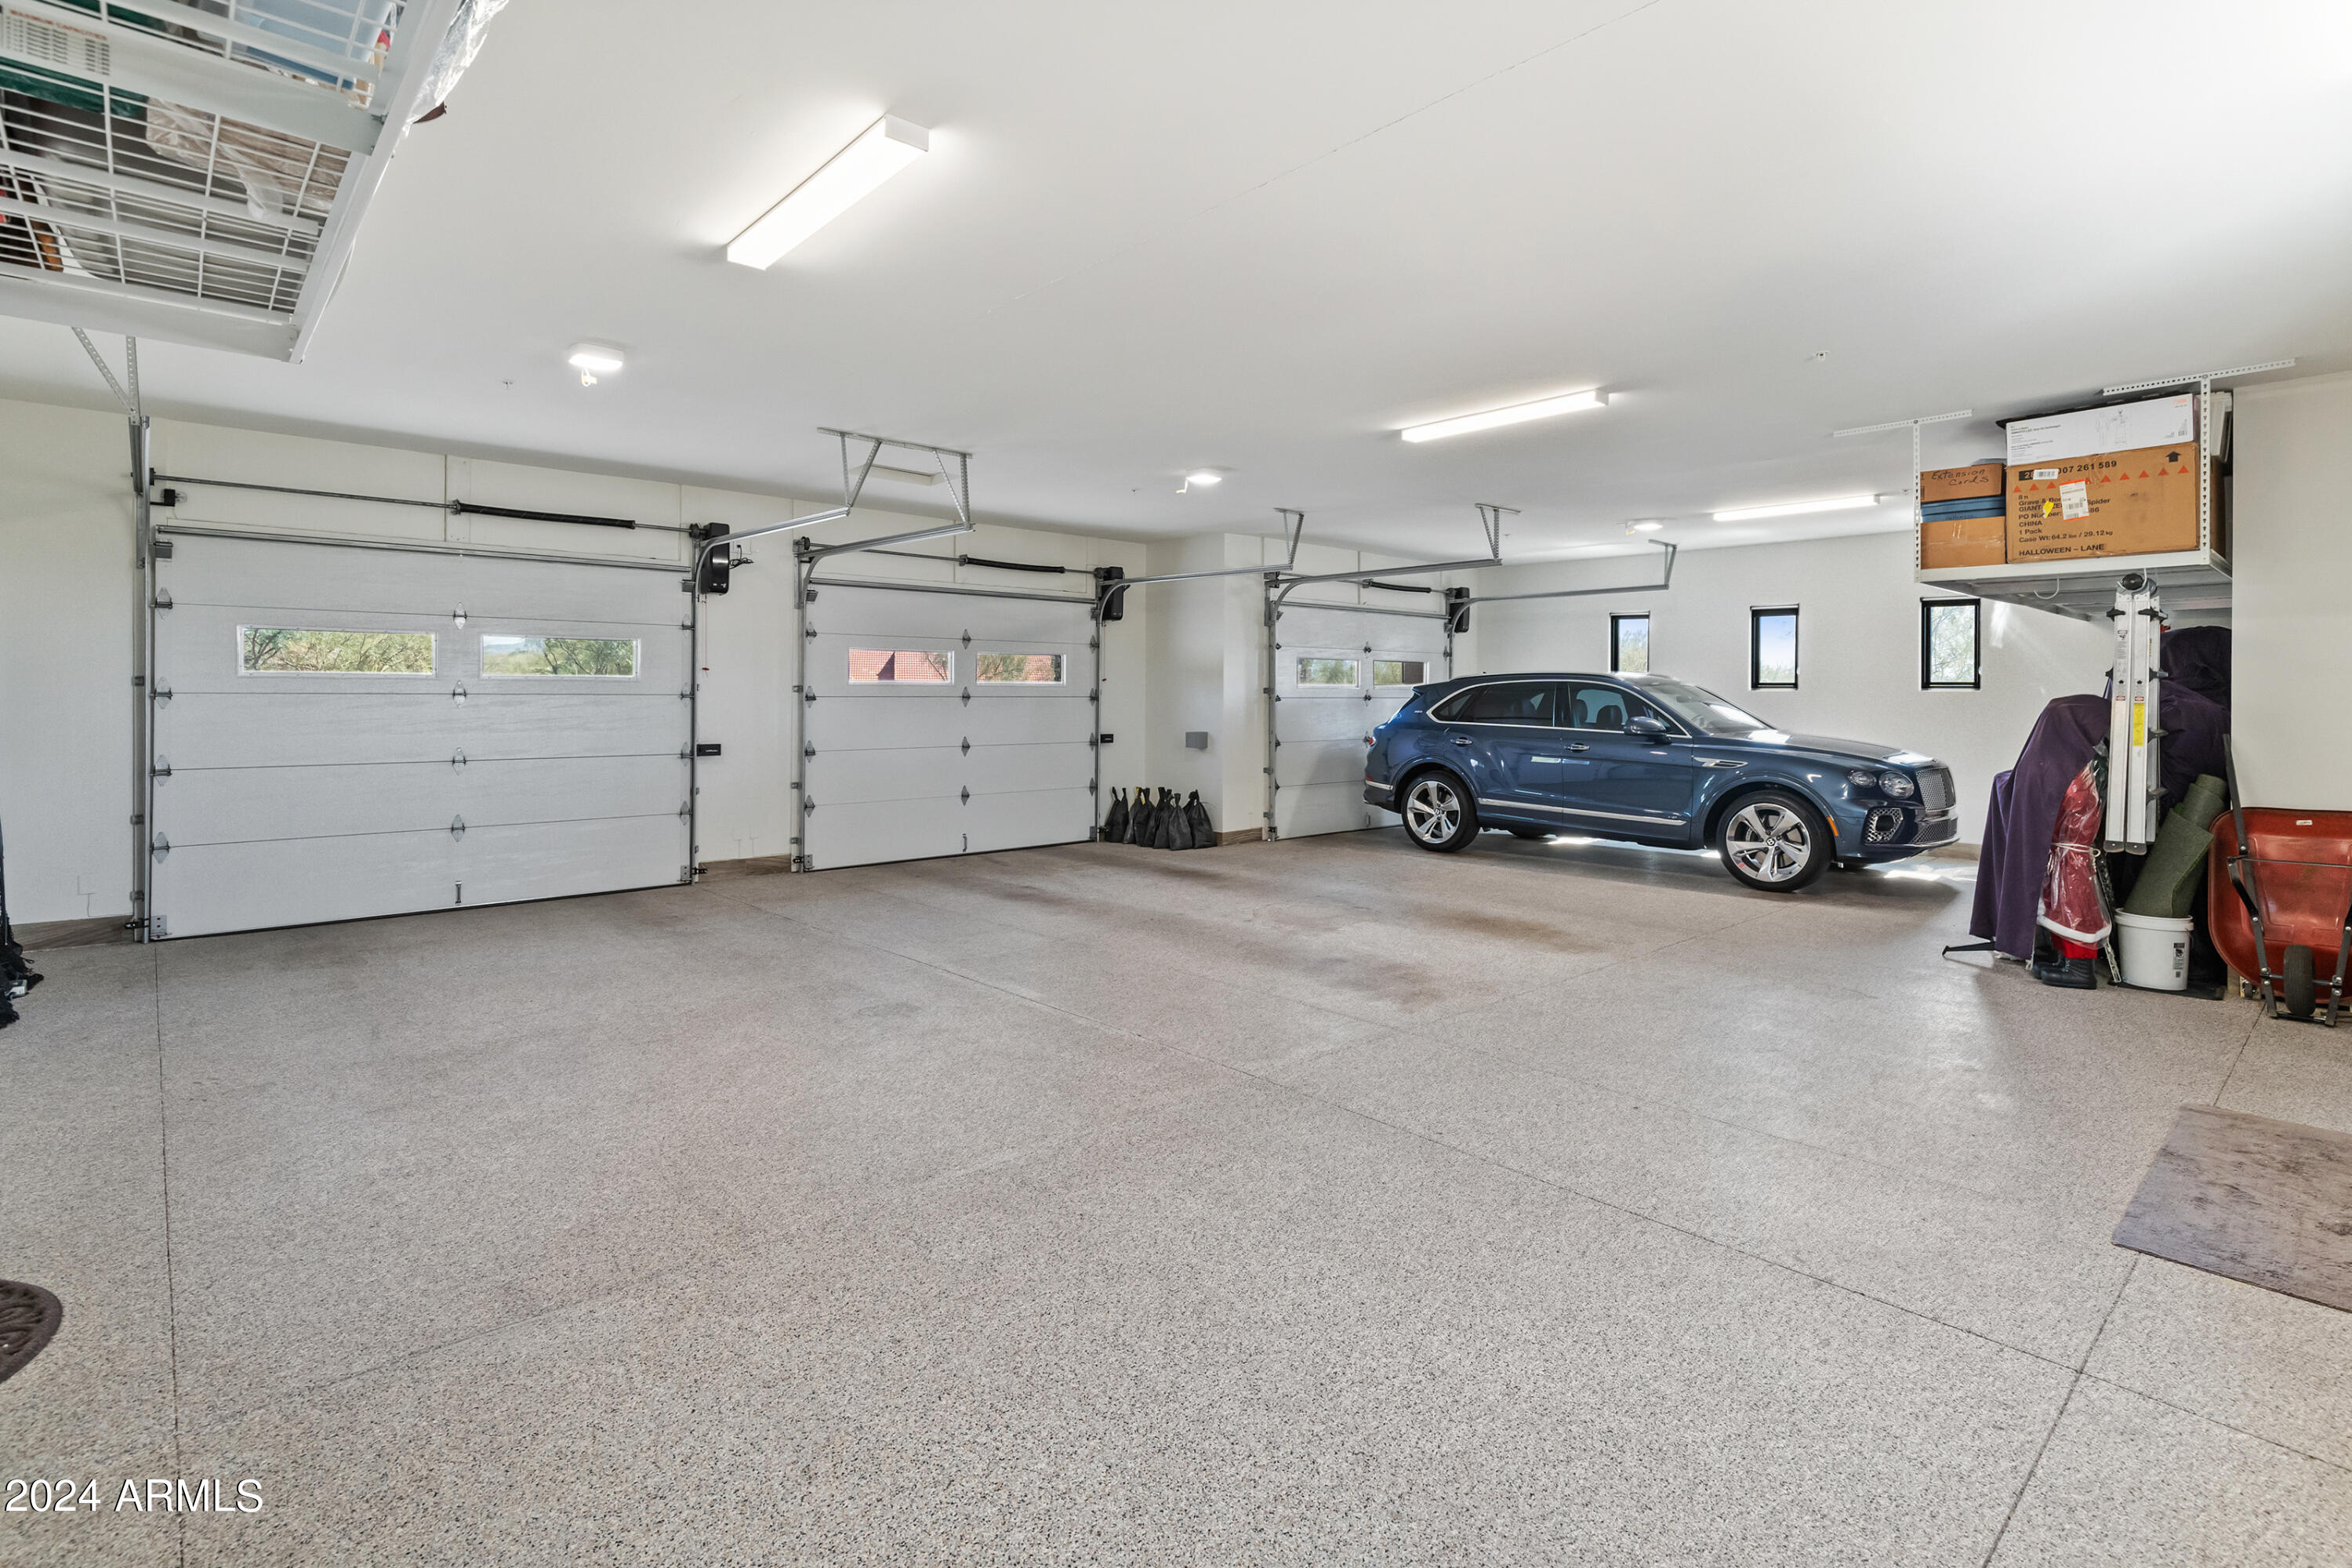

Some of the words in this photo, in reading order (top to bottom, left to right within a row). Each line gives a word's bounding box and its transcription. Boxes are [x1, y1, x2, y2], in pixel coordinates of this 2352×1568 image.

[2098, 460, 2117, 469] 589
[1931, 469, 1985, 481] Extension
[2019, 546, 2071, 556] HALLOWEEN
[2081, 543, 2105, 552] LANE
